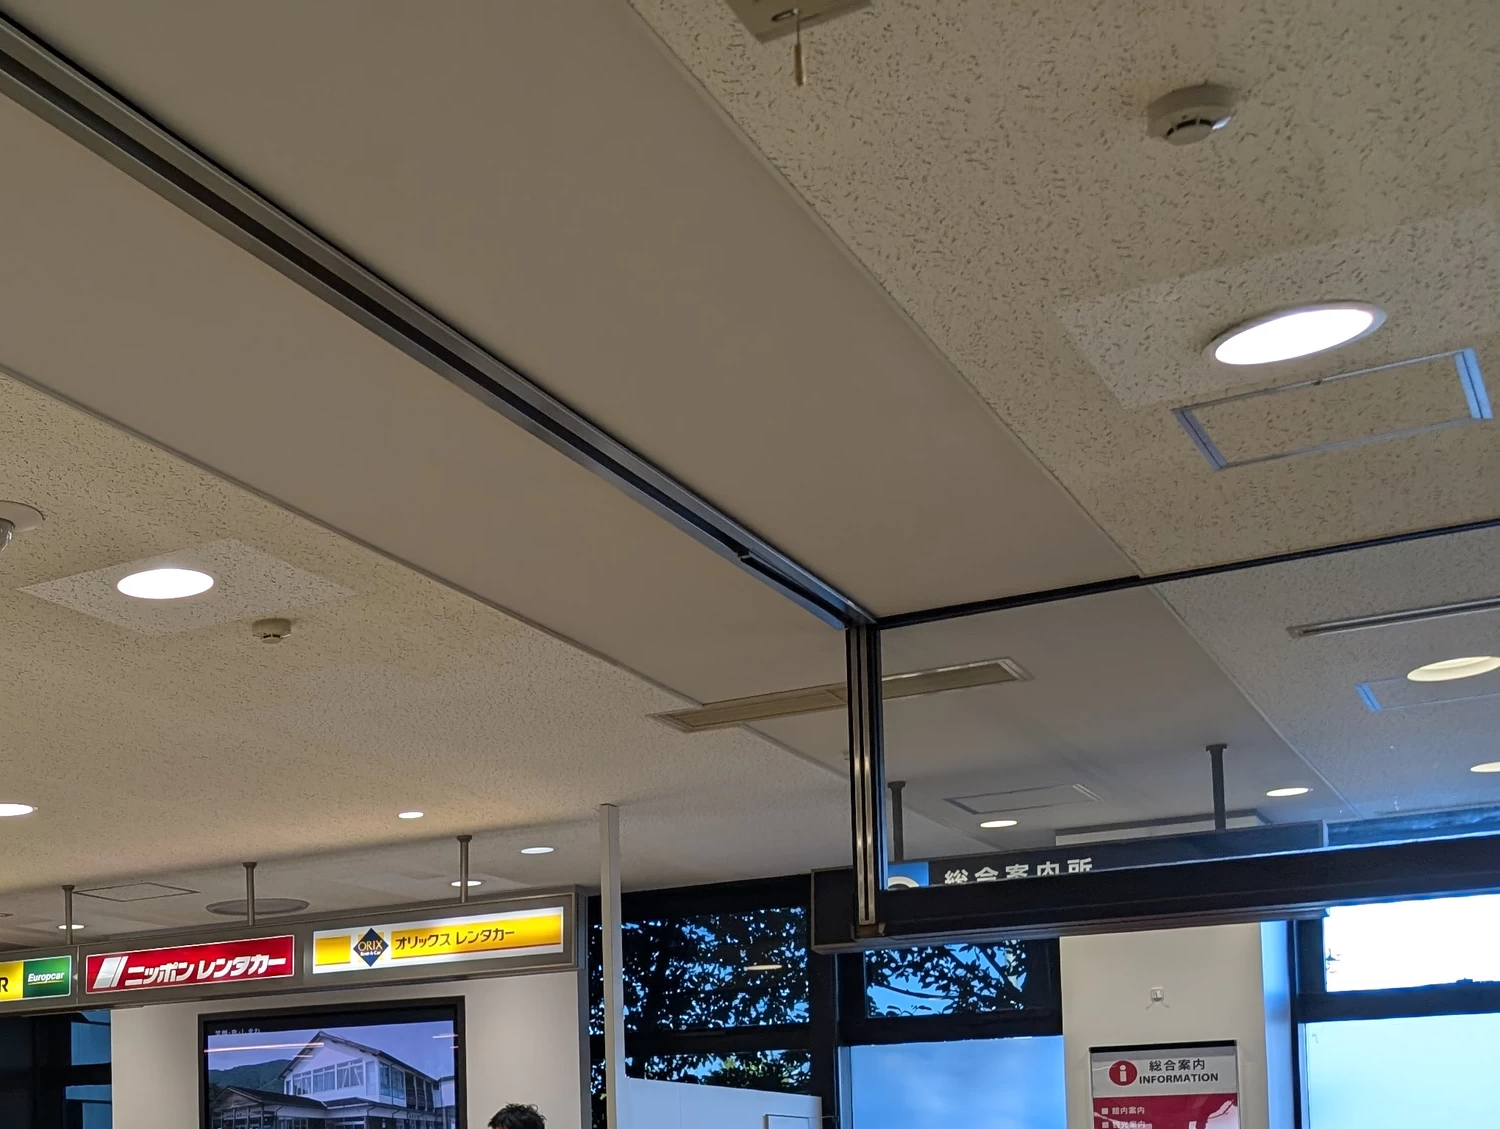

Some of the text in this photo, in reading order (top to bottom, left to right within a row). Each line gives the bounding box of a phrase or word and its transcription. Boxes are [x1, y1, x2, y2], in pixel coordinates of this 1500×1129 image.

[358, 940, 383, 951] ORIX
[394, 928, 515, 951] オリックス レンタカー
[28, 971, 65, 984] Europcar
[124, 956, 286, 986] ニッポン レンタカー
[1148, 1058, 1205, 1072] 総合案内
[1140, 1073, 1218, 1084] INFORMATION
[1112, 1106, 1145, 1114] 館内案内
